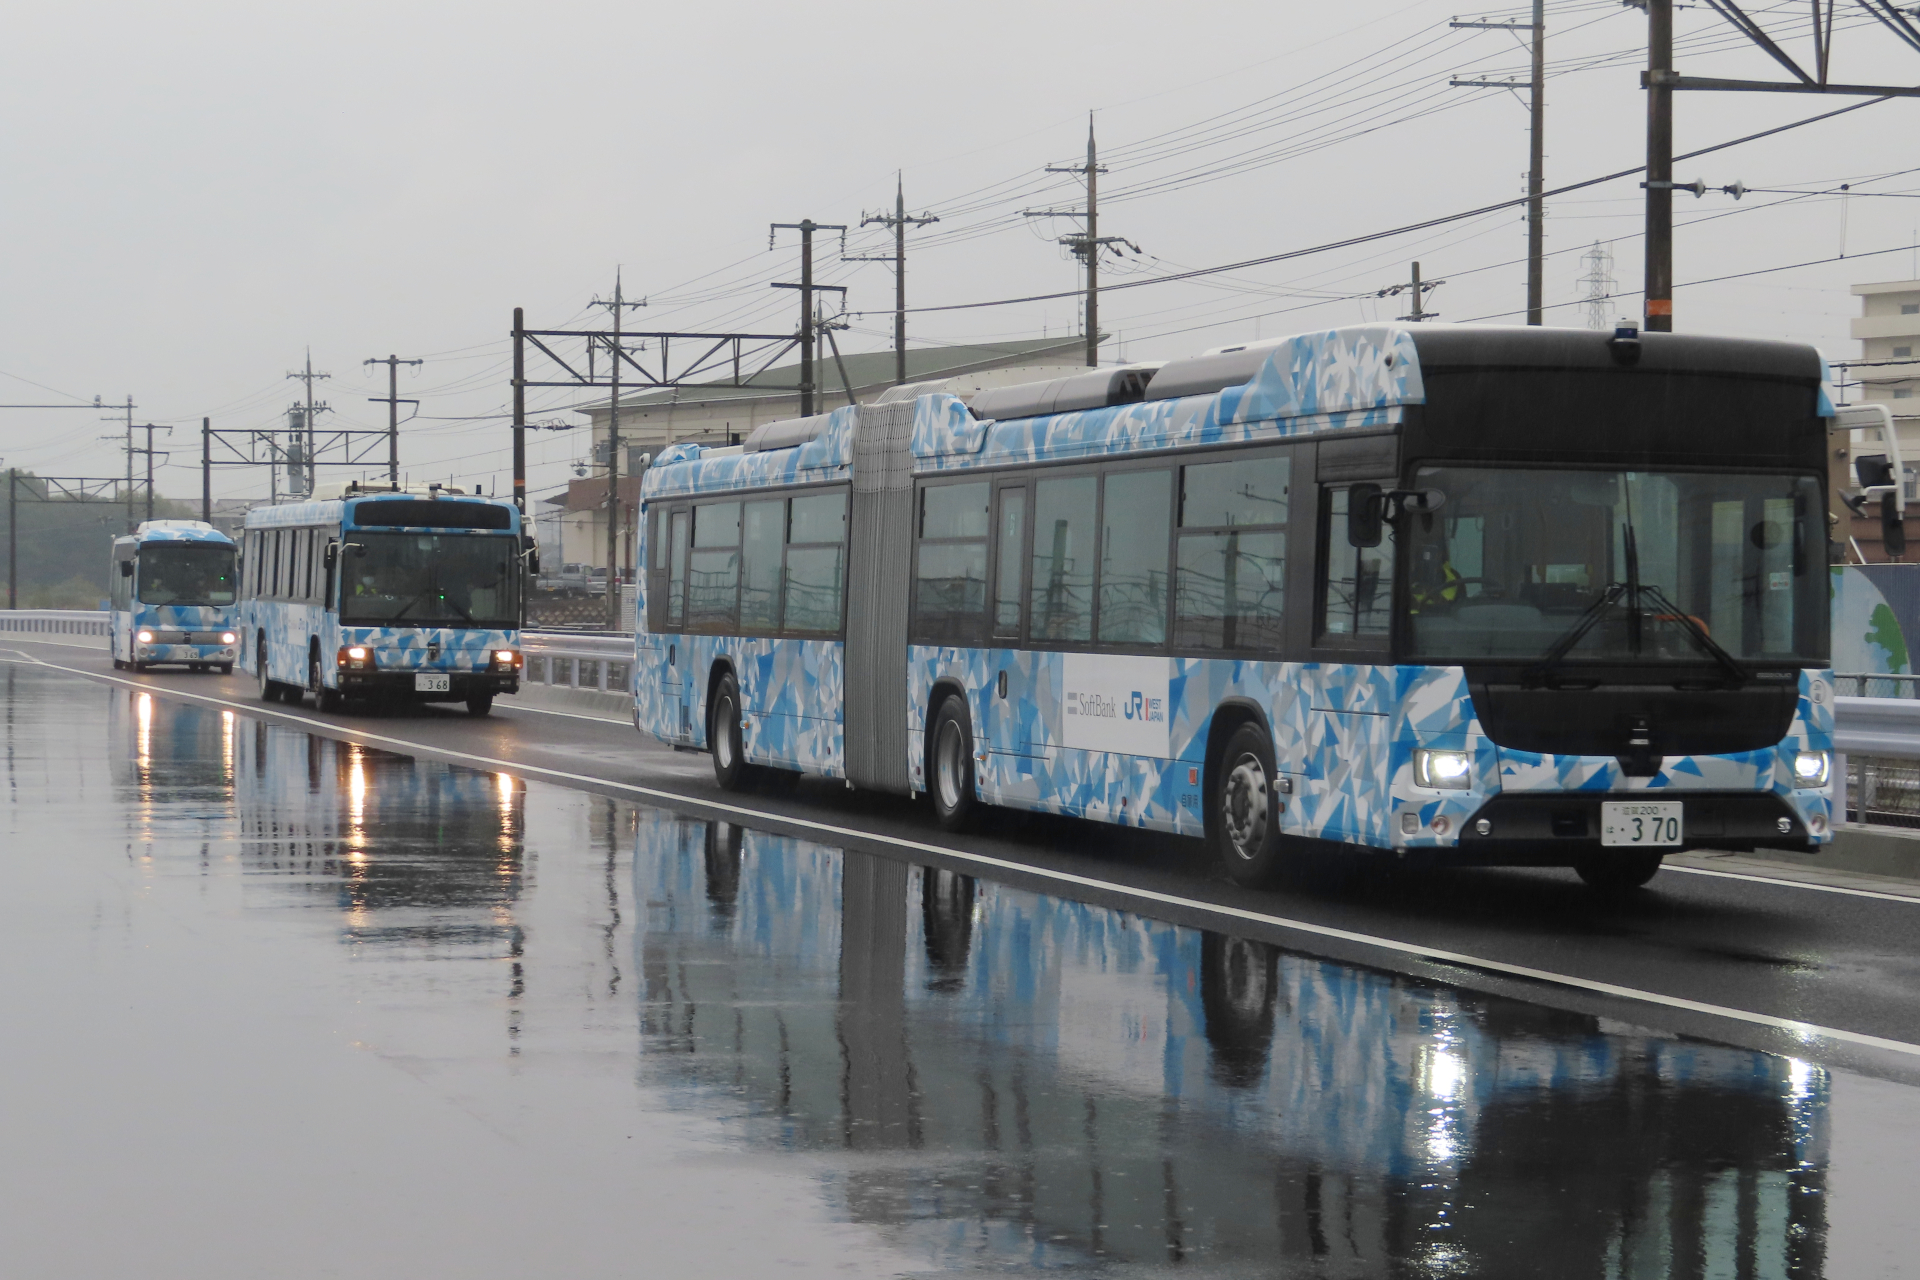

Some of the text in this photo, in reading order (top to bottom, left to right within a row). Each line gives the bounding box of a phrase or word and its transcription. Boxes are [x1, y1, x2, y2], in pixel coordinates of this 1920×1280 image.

[184, 651, 198, 659] 369
[427, 680, 448, 690] 368
[1079, 691, 1142, 720] SoftBank JR
[1148, 699, 1162, 710] WEST
[1148, 710, 1164, 722] JAPAN
[1631, 817, 1678, 842] 370
